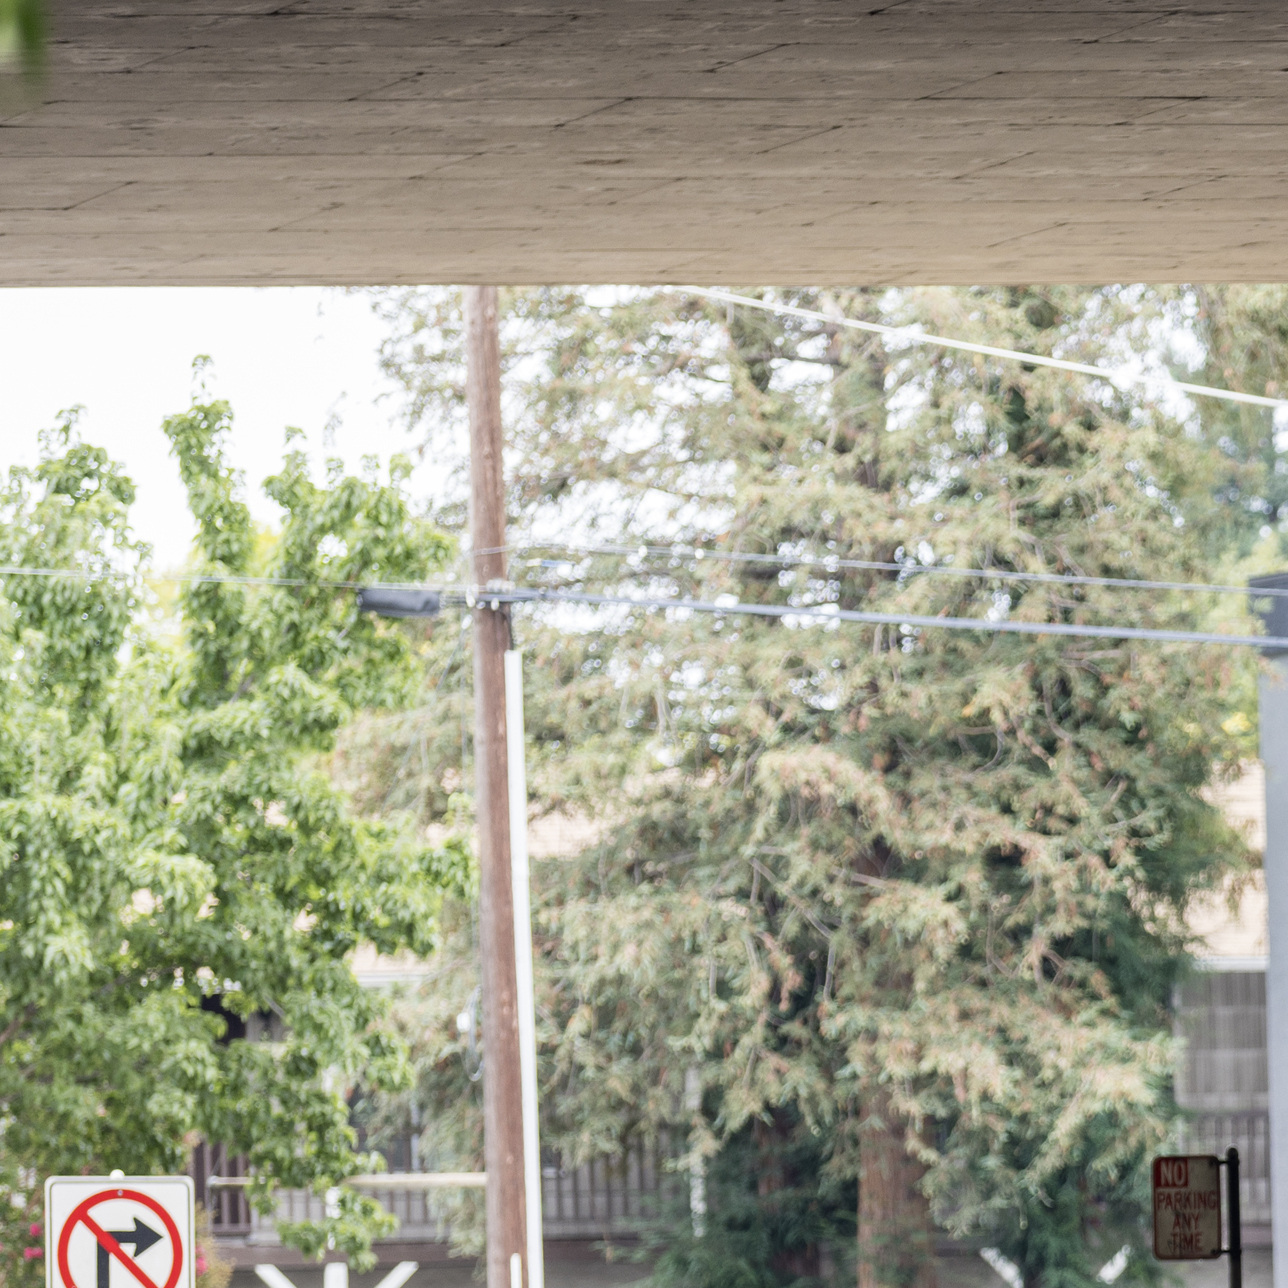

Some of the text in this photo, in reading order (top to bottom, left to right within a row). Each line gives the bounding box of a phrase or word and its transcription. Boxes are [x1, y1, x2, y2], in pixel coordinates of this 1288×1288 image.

[1160, 1160, 1186, 1186] NO
[1156, 1190, 1218, 1210] PARKING
[1172, 1211, 1201, 1230] ANY
[1170, 1232, 1203, 1252] TIME
